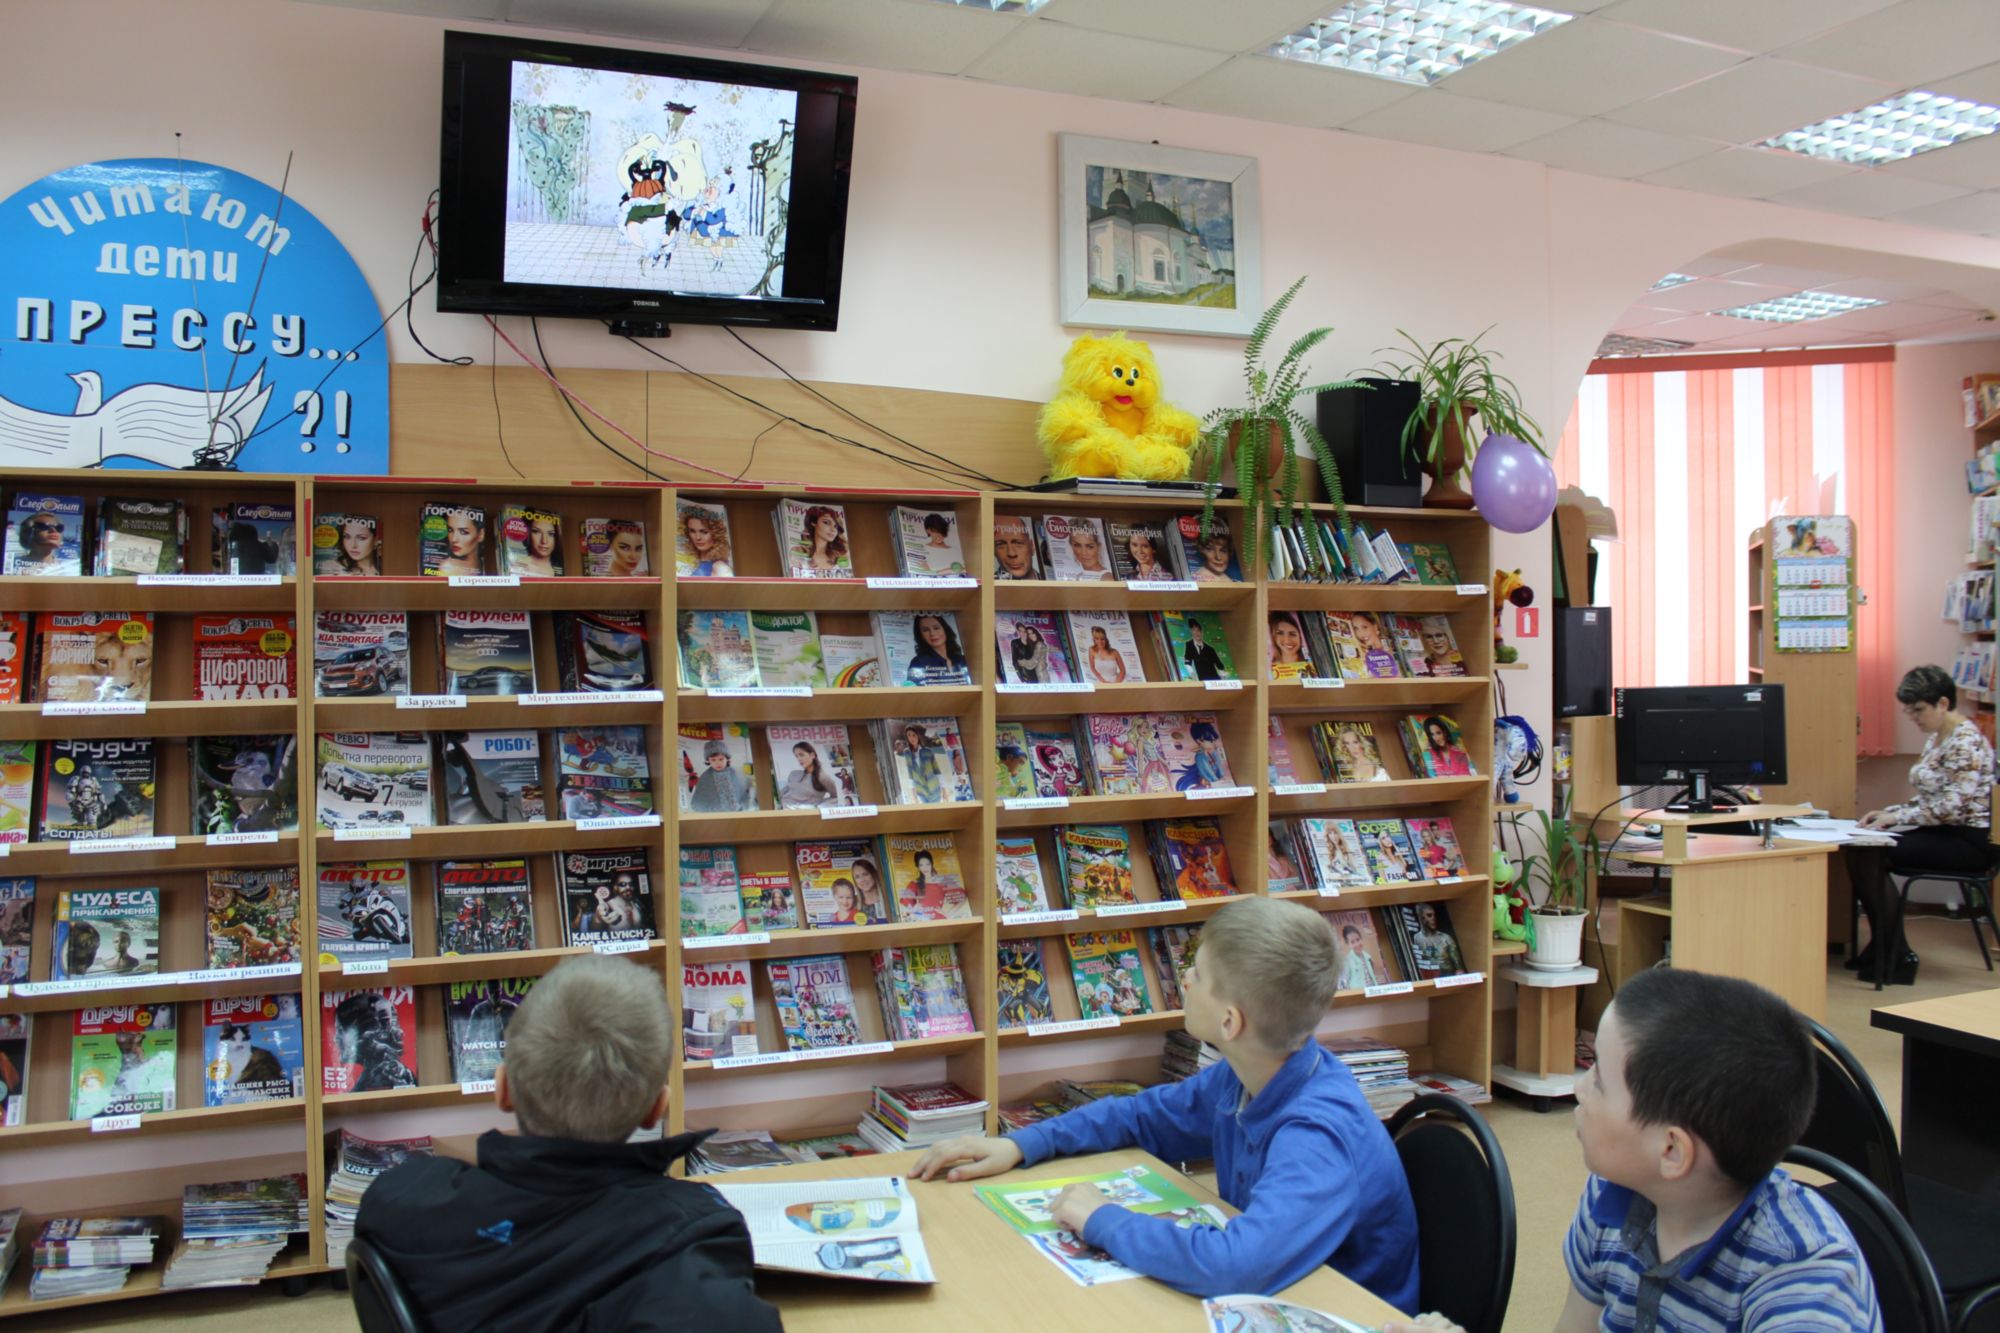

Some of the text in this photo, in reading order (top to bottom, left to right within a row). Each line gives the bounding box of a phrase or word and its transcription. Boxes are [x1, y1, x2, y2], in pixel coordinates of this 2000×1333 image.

[28, 182, 292, 256] Читают
[96, 241, 238, 283] дети
[16, 296, 359, 361] ПРЕССУ...
[425, 505, 485, 522] ГОРОСКОП
[505, 506, 561, 526] ГОРОСКОП
[315, 515, 377, 529] ГОРОСКОП
[587, 521, 643, 537] ГОРОСКОП
[1048, 519, 1100, 538] Биография
[1110, 523, 1163, 540] Биография
[457, 575, 512, 586] Гороскоп
[336, 634, 385, 644] SPORTAGE
[200, 655, 288, 686] ЦИФРОВОЙ
[404, 697, 457, 709] За рулём
[527, 693, 553, 703] Мир
[770, 726, 845, 740] ВЯЗАНИЕ
[323, 742, 423, 765] Попытка переворота
[381, 784, 395, 807] 7
[583, 819, 616, 829] Юный
[1359, 822, 1402, 834] OOPS!
[49, 829, 111, 839] СОЛДАТЫ
[216, 832, 269, 842] Свирель
[1068, 832, 1122, 848] КЛАССНЫЙ
[798, 848, 831, 864] Все
[320, 868, 406, 882] МОТО
[443, 868, 526, 884] МОТО
[444, 886, 485, 895] СПОРТБАЙКИ
[72, 890, 157, 907] ЧУДЕСА
[71, 907, 157, 918] ПРИКЛЮЧЕНИЯ
[572, 932, 601, 942] KANE
[601, 932, 610, 941] &
[610, 931, 644, 942] LYNCH
[189, 965, 292, 981] Наука и религия
[350, 962, 382, 972] Мото
[683, 971, 747, 988] ДОМА
[1034, 1024, 1060, 1033] Шрек
[462, 1041, 498, 1051] WATCH
[716, 1051, 744, 1061] Магия
[324, 1067, 348, 1082] E3
[266, 1078, 290, 1088] РЫСЬ
[324, 1081, 348, 1090] 2016
[104, 1100, 162, 1115] СОКОКЕ
[99, 1117, 133, 1130] Друг
